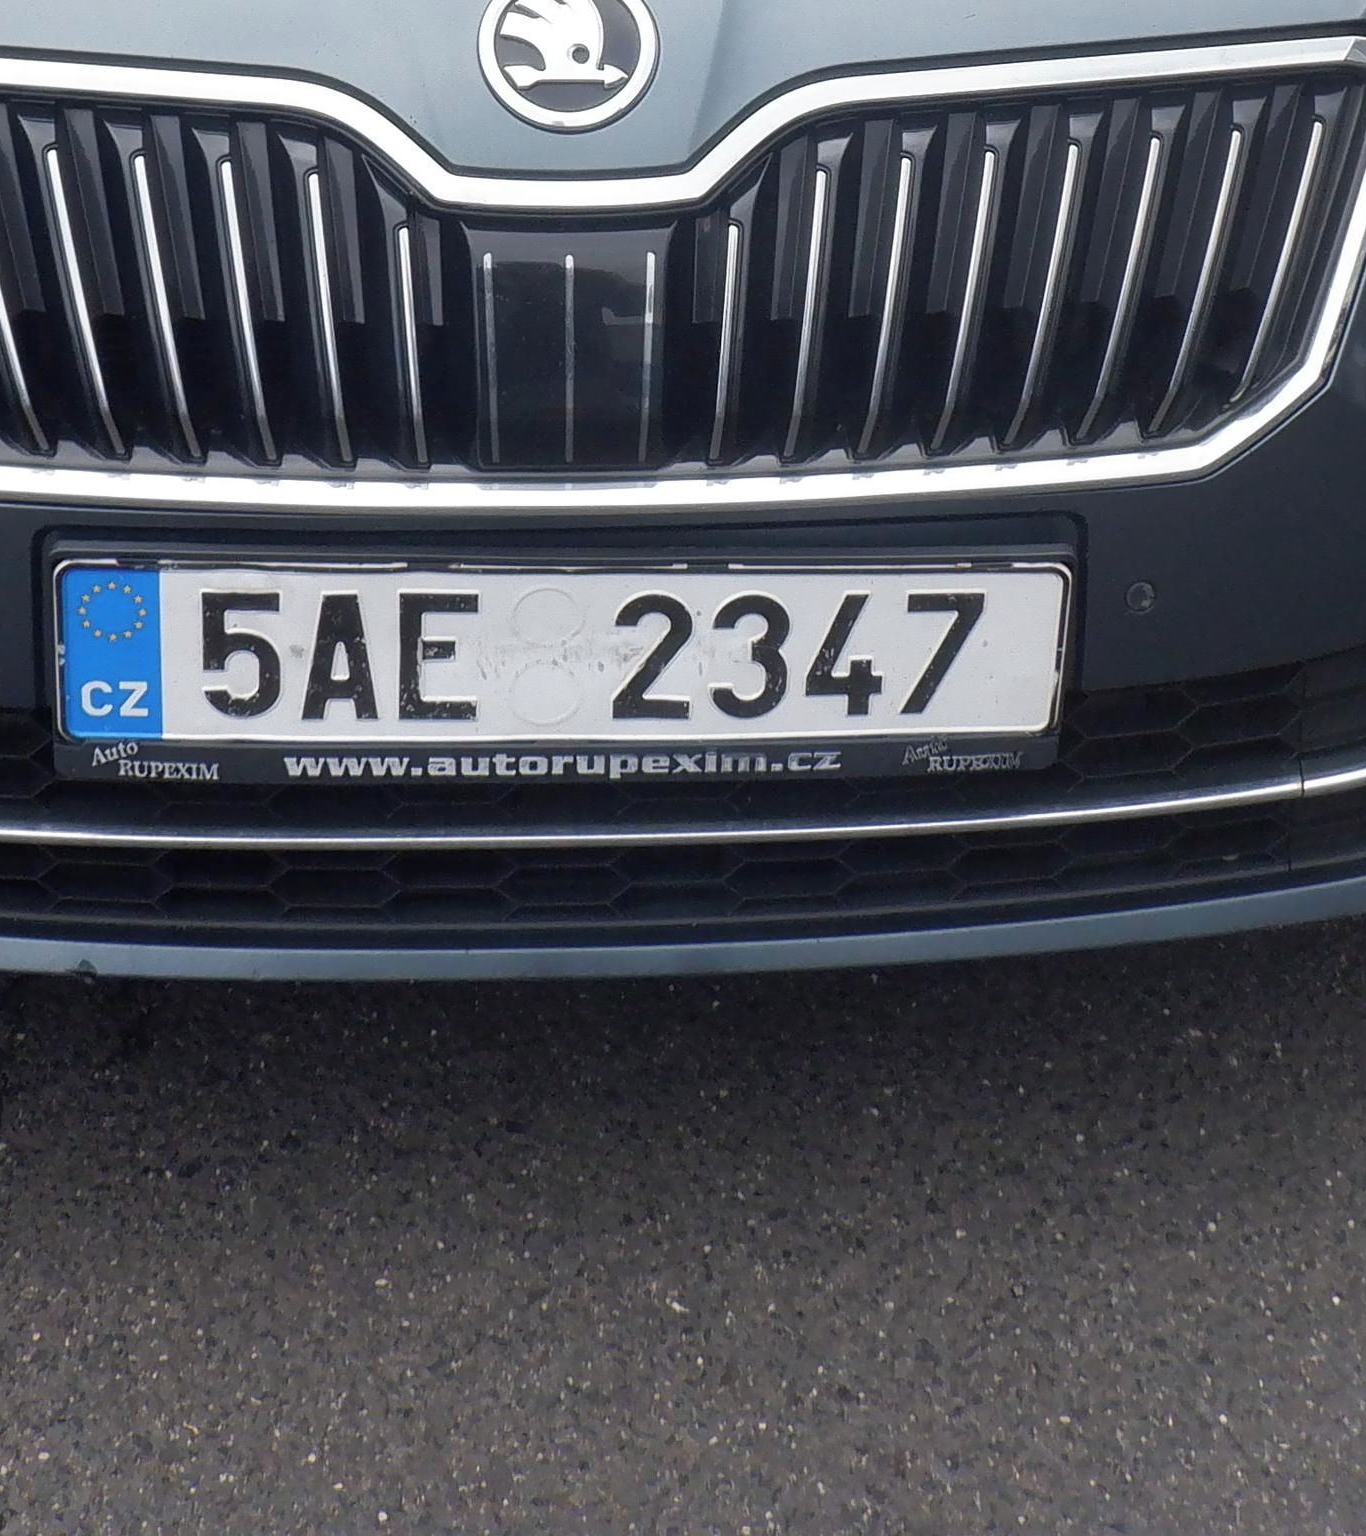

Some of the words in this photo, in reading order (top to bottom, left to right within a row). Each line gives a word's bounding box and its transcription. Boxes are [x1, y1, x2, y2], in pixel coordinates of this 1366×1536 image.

[200, 592, 480, 721] 5AE
[611, 591, 987, 720] 2347
[80, 680, 150, 718] CZ
[91, 740, 139, 767] Auto
[117, 758, 221, 781] RUPEXIM
[283, 747, 842, 779] www.autorupexim.cz
